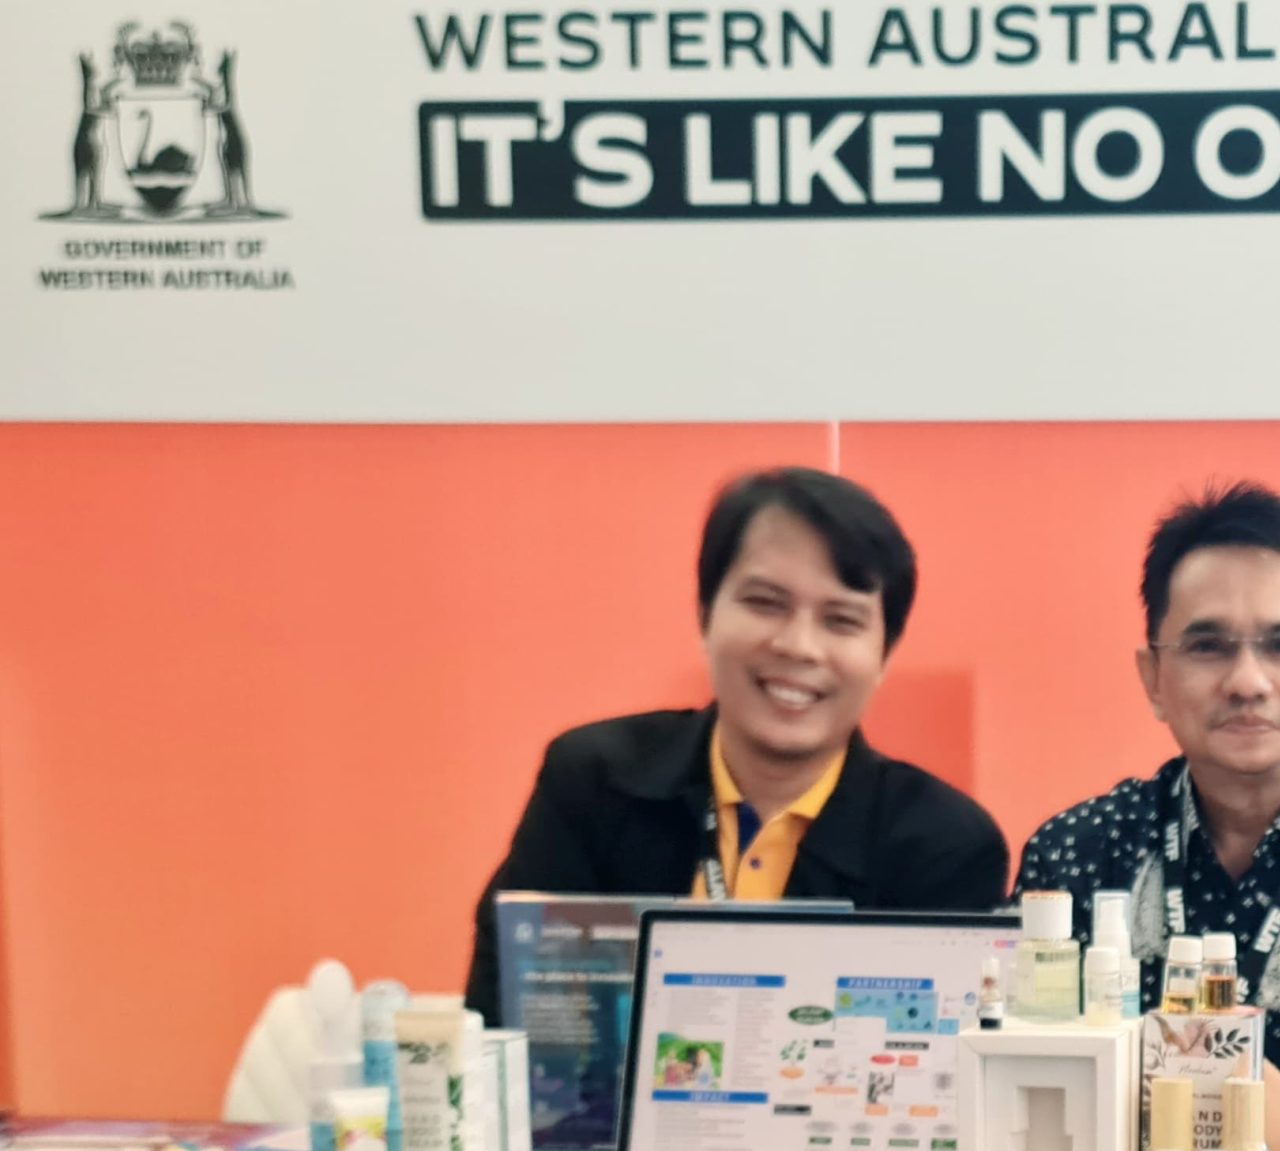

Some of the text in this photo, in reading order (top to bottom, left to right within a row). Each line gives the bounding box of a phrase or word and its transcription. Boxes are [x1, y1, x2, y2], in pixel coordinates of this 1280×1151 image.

[416, 12, 833, 71] WESTERN
[430, 104, 654, 209] IT'S
[686, 111, 943, 206] LIKE
[978, 107, 1165, 202] NO
[64, 239, 264, 259] GOVERNMENT OF
[40, 269, 295, 289] WESTERN AUSTRALIA
[1167, 888, 1185, 934] WTF
[1193, 1124, 1223, 1136] ODY
